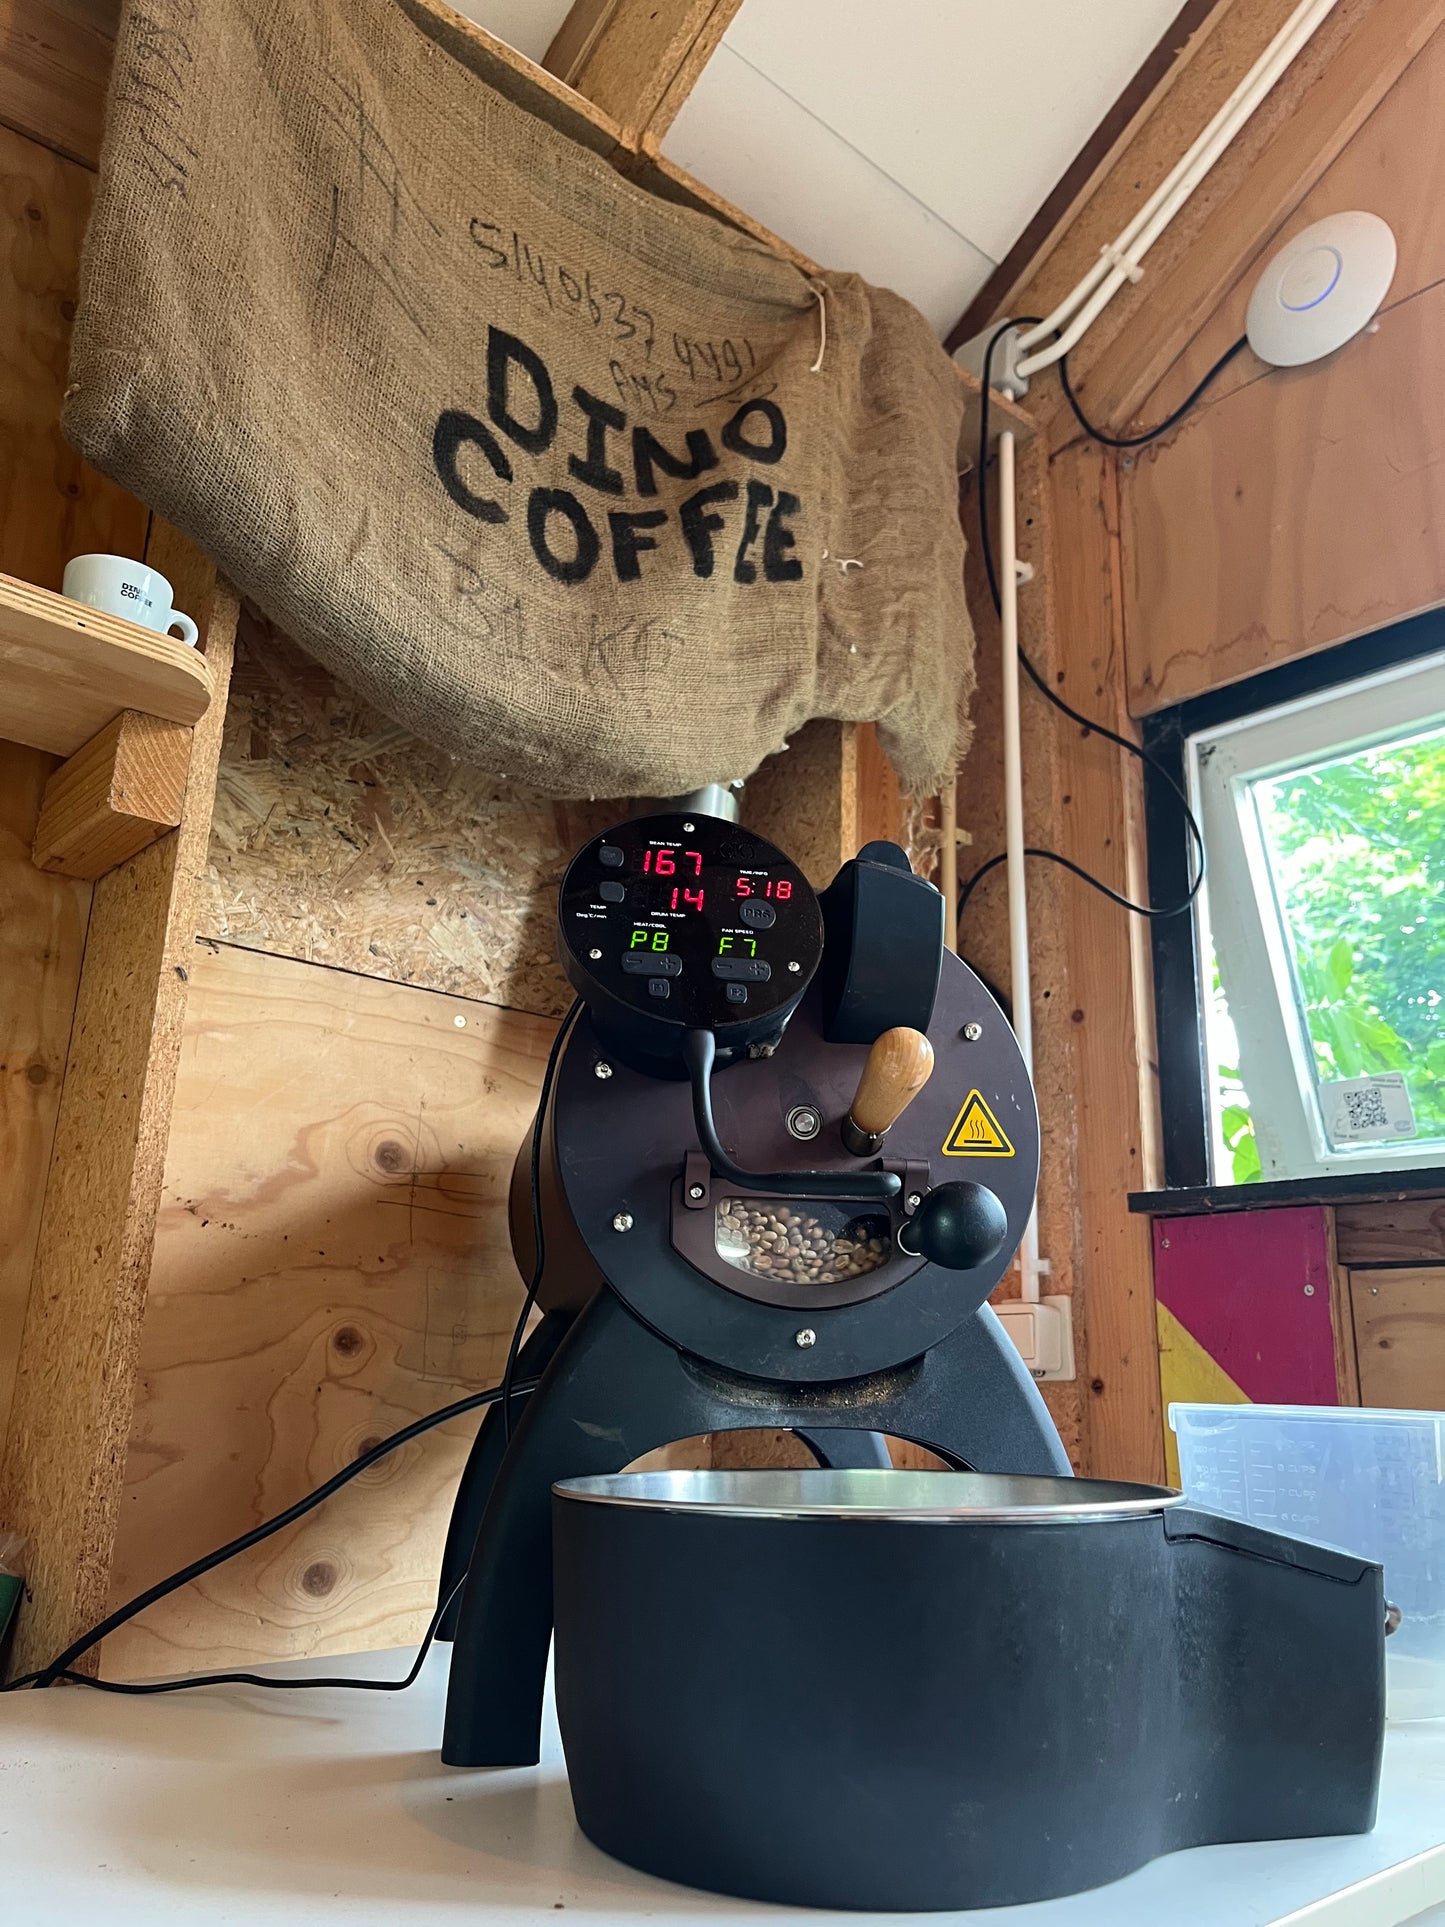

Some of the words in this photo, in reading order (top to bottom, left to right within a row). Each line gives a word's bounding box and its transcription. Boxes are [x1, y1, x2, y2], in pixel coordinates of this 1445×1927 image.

[487, 324, 788, 497] DINO
[433, 408, 803, 586] COFFEE
[120, 589, 153, 608] COFEE
[643, 849, 702, 876] 167
[671, 887, 704, 911] 14
[736, 877, 792, 899] 5:18
[743, 908, 771, 918] PRS
